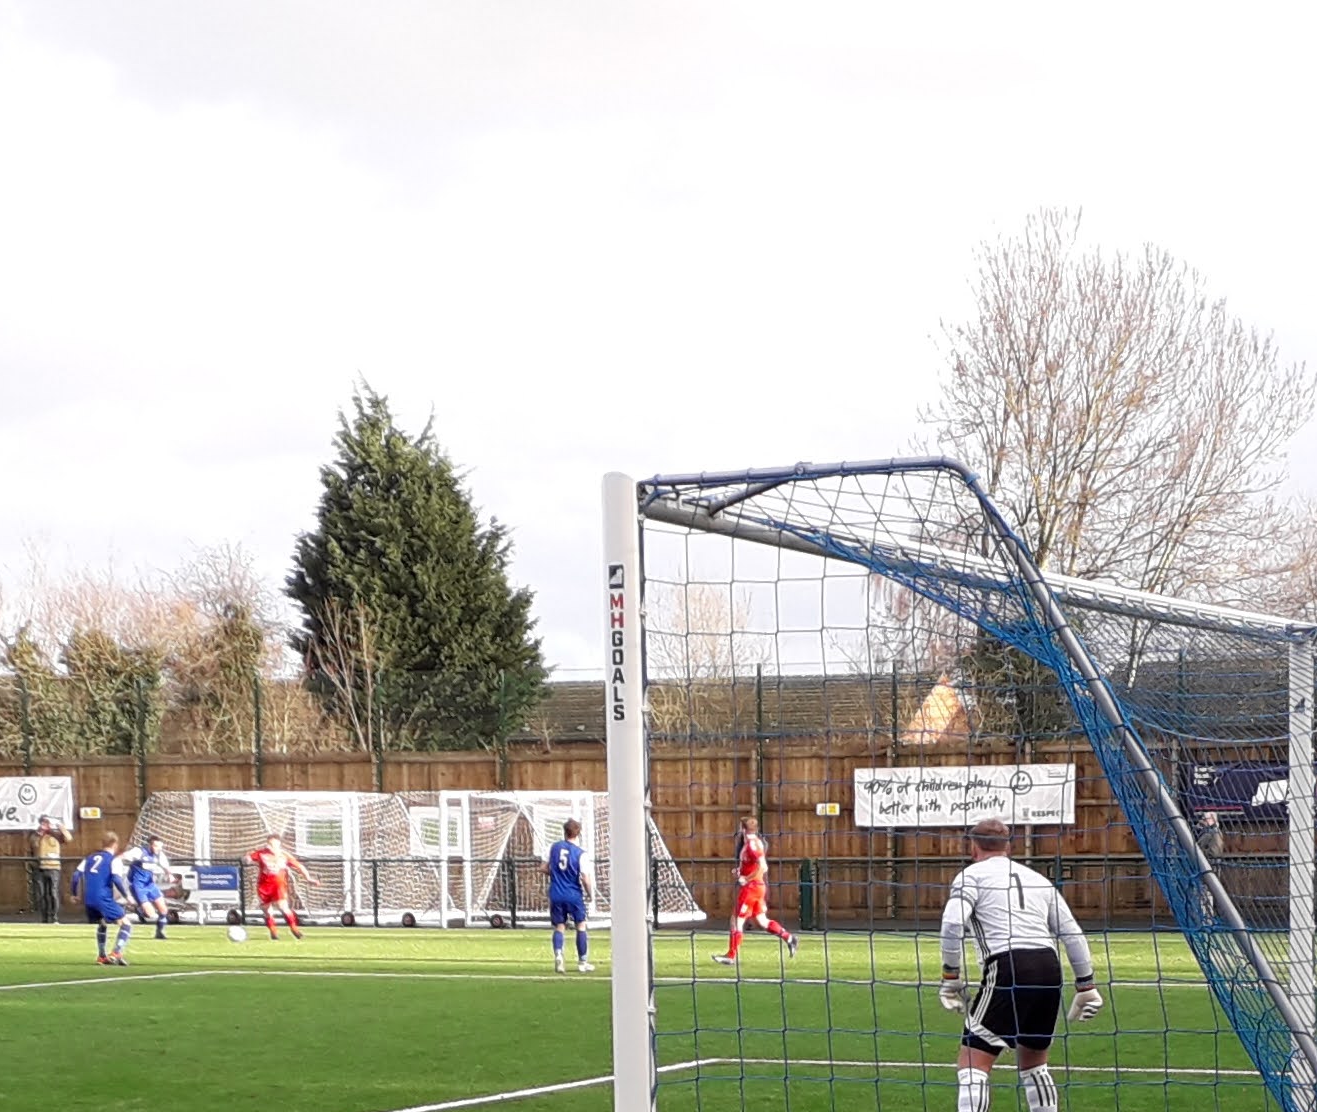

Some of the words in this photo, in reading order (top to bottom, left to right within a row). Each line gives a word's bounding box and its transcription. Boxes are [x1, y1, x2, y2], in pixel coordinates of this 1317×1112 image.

[609, 592, 625, 721] MHGOALS
[897, 775, 911, 795] of
[915, 777, 963, 792] children
[966, 774, 991, 795] play
[879, 800, 912, 816] better
[917, 798, 941, 814] with
[950, 795, 1006, 816] positivity
[90, 855, 104, 873] 2
[558, 848, 570, 870] 5
[1009, 872, 1025, 910] 1
